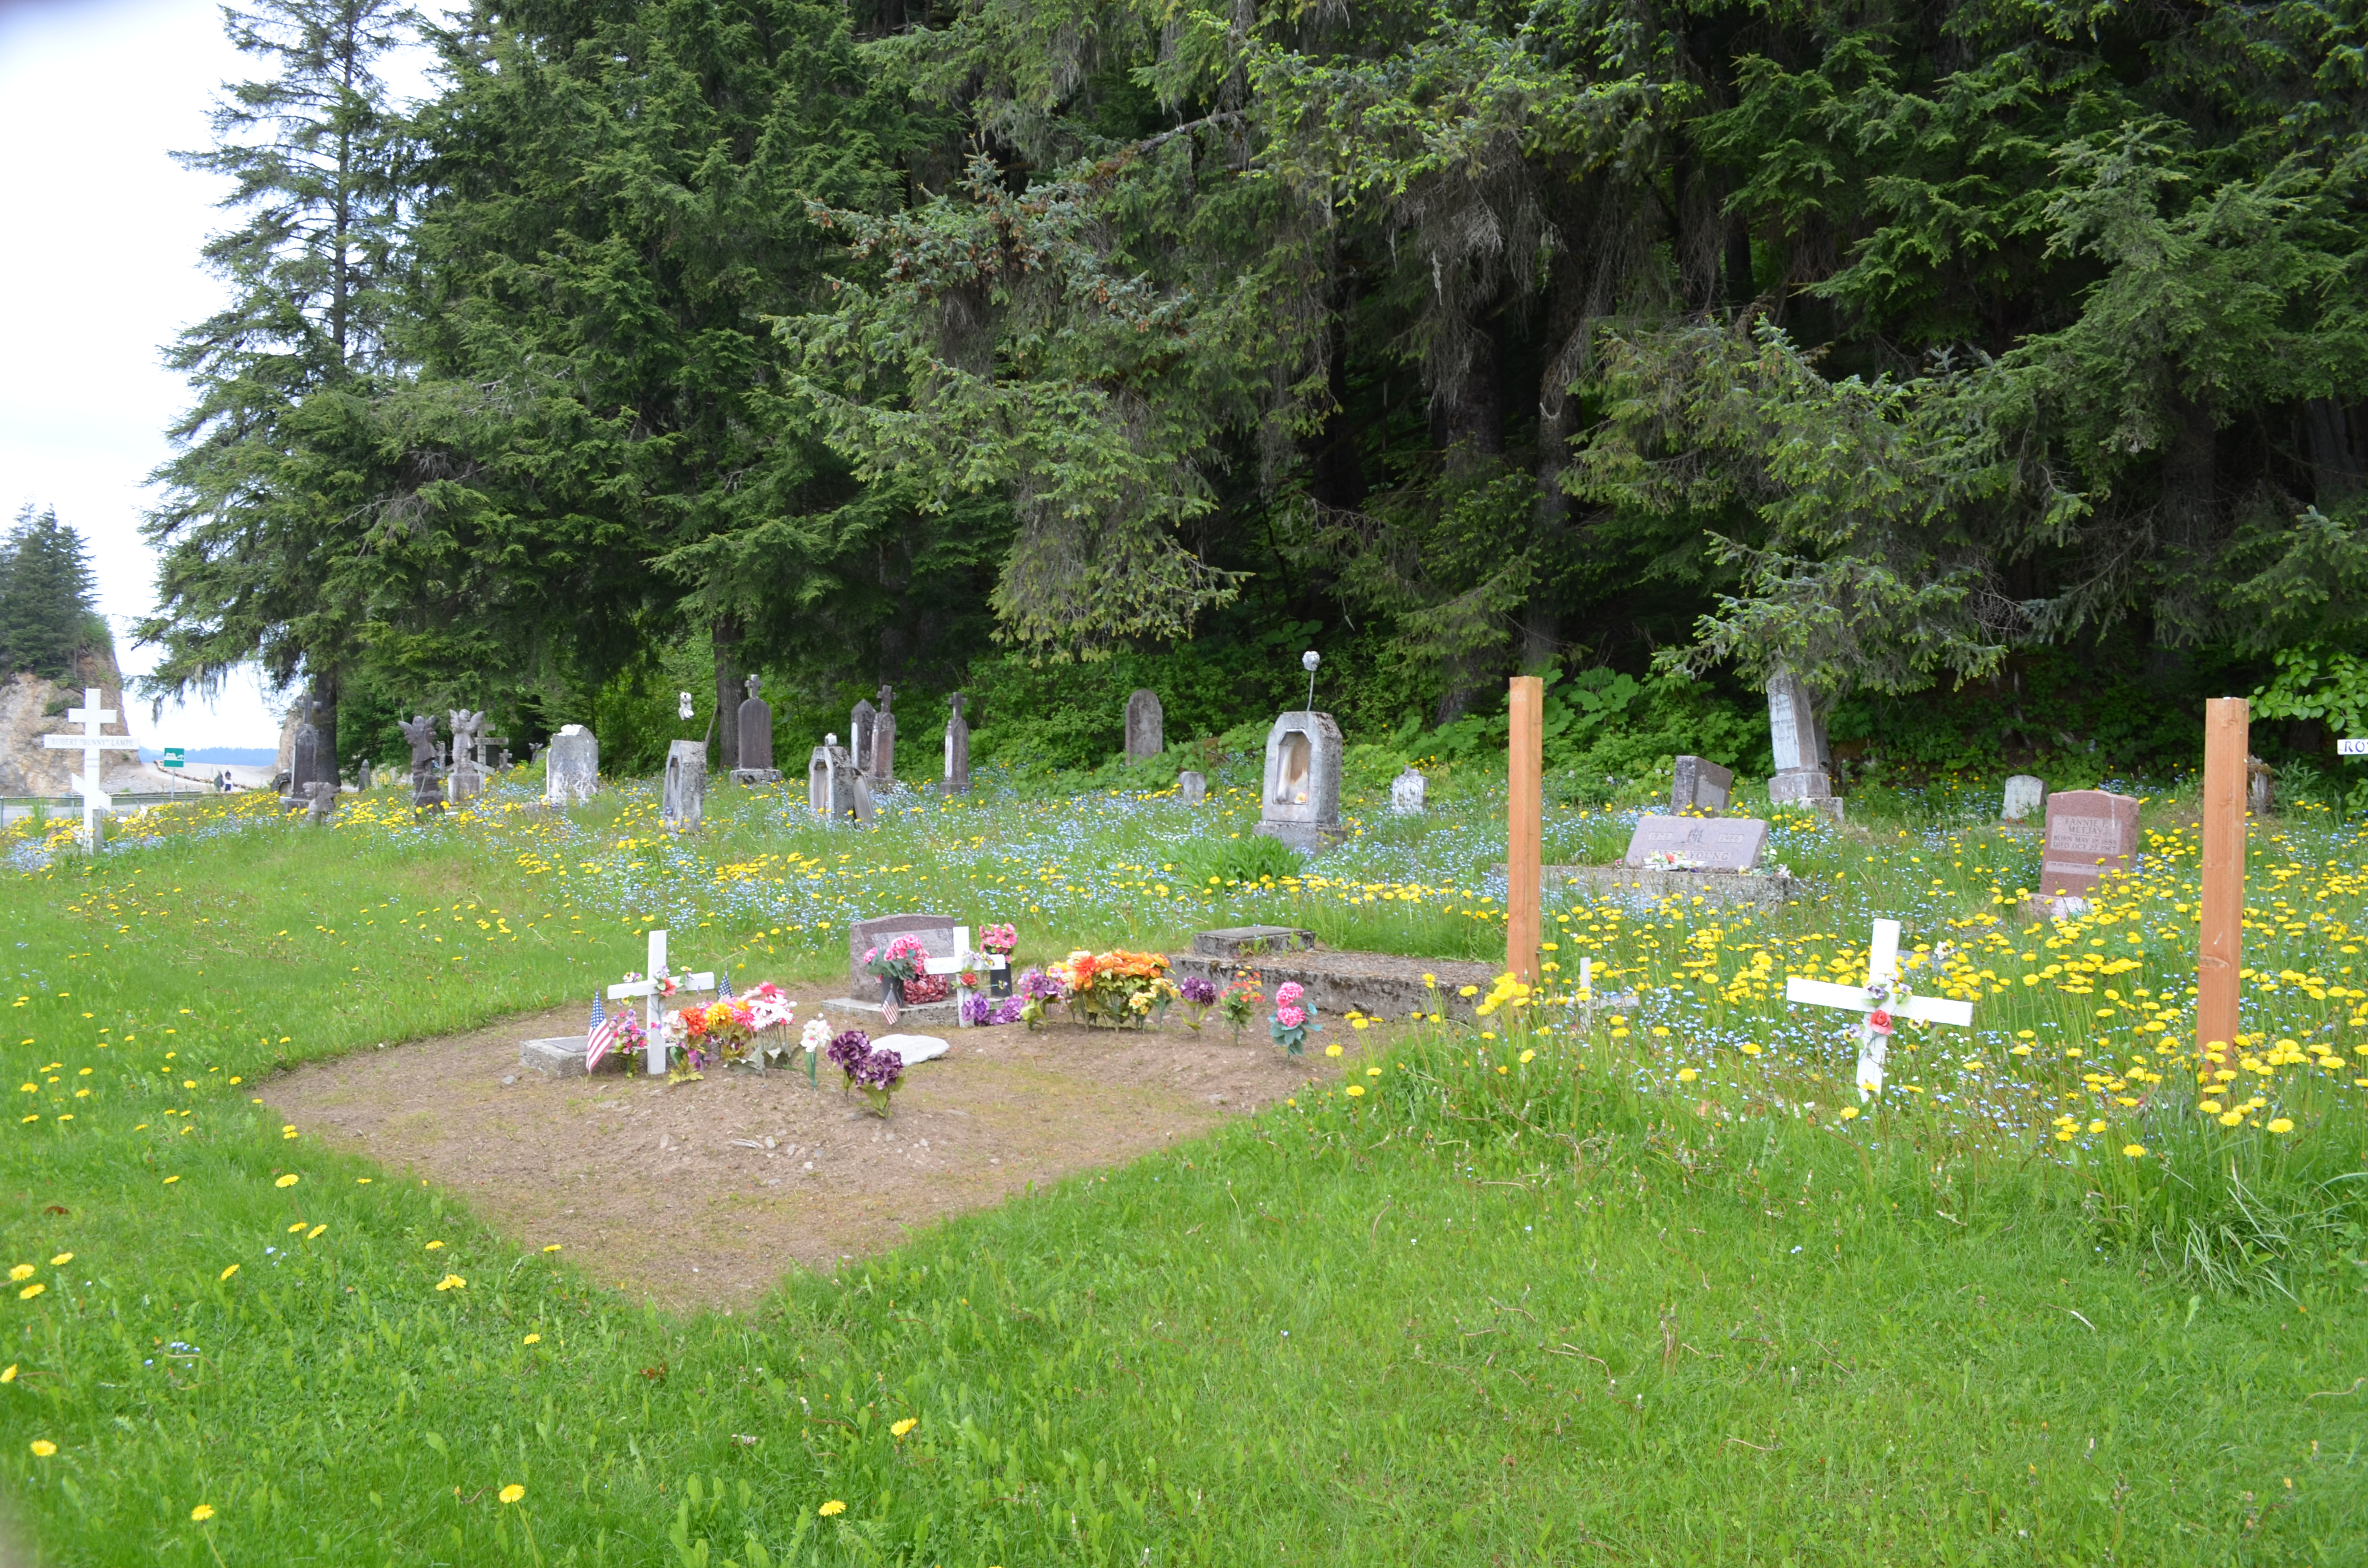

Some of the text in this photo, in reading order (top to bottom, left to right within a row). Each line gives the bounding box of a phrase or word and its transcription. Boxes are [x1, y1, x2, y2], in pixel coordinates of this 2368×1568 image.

[2344, 741, 2368, 753] RO
[2065, 818, 2098, 827] FANNIE
[2069, 826, 2103, 835] METJAY
[1690, 851, 1729, 860] YOUNG
